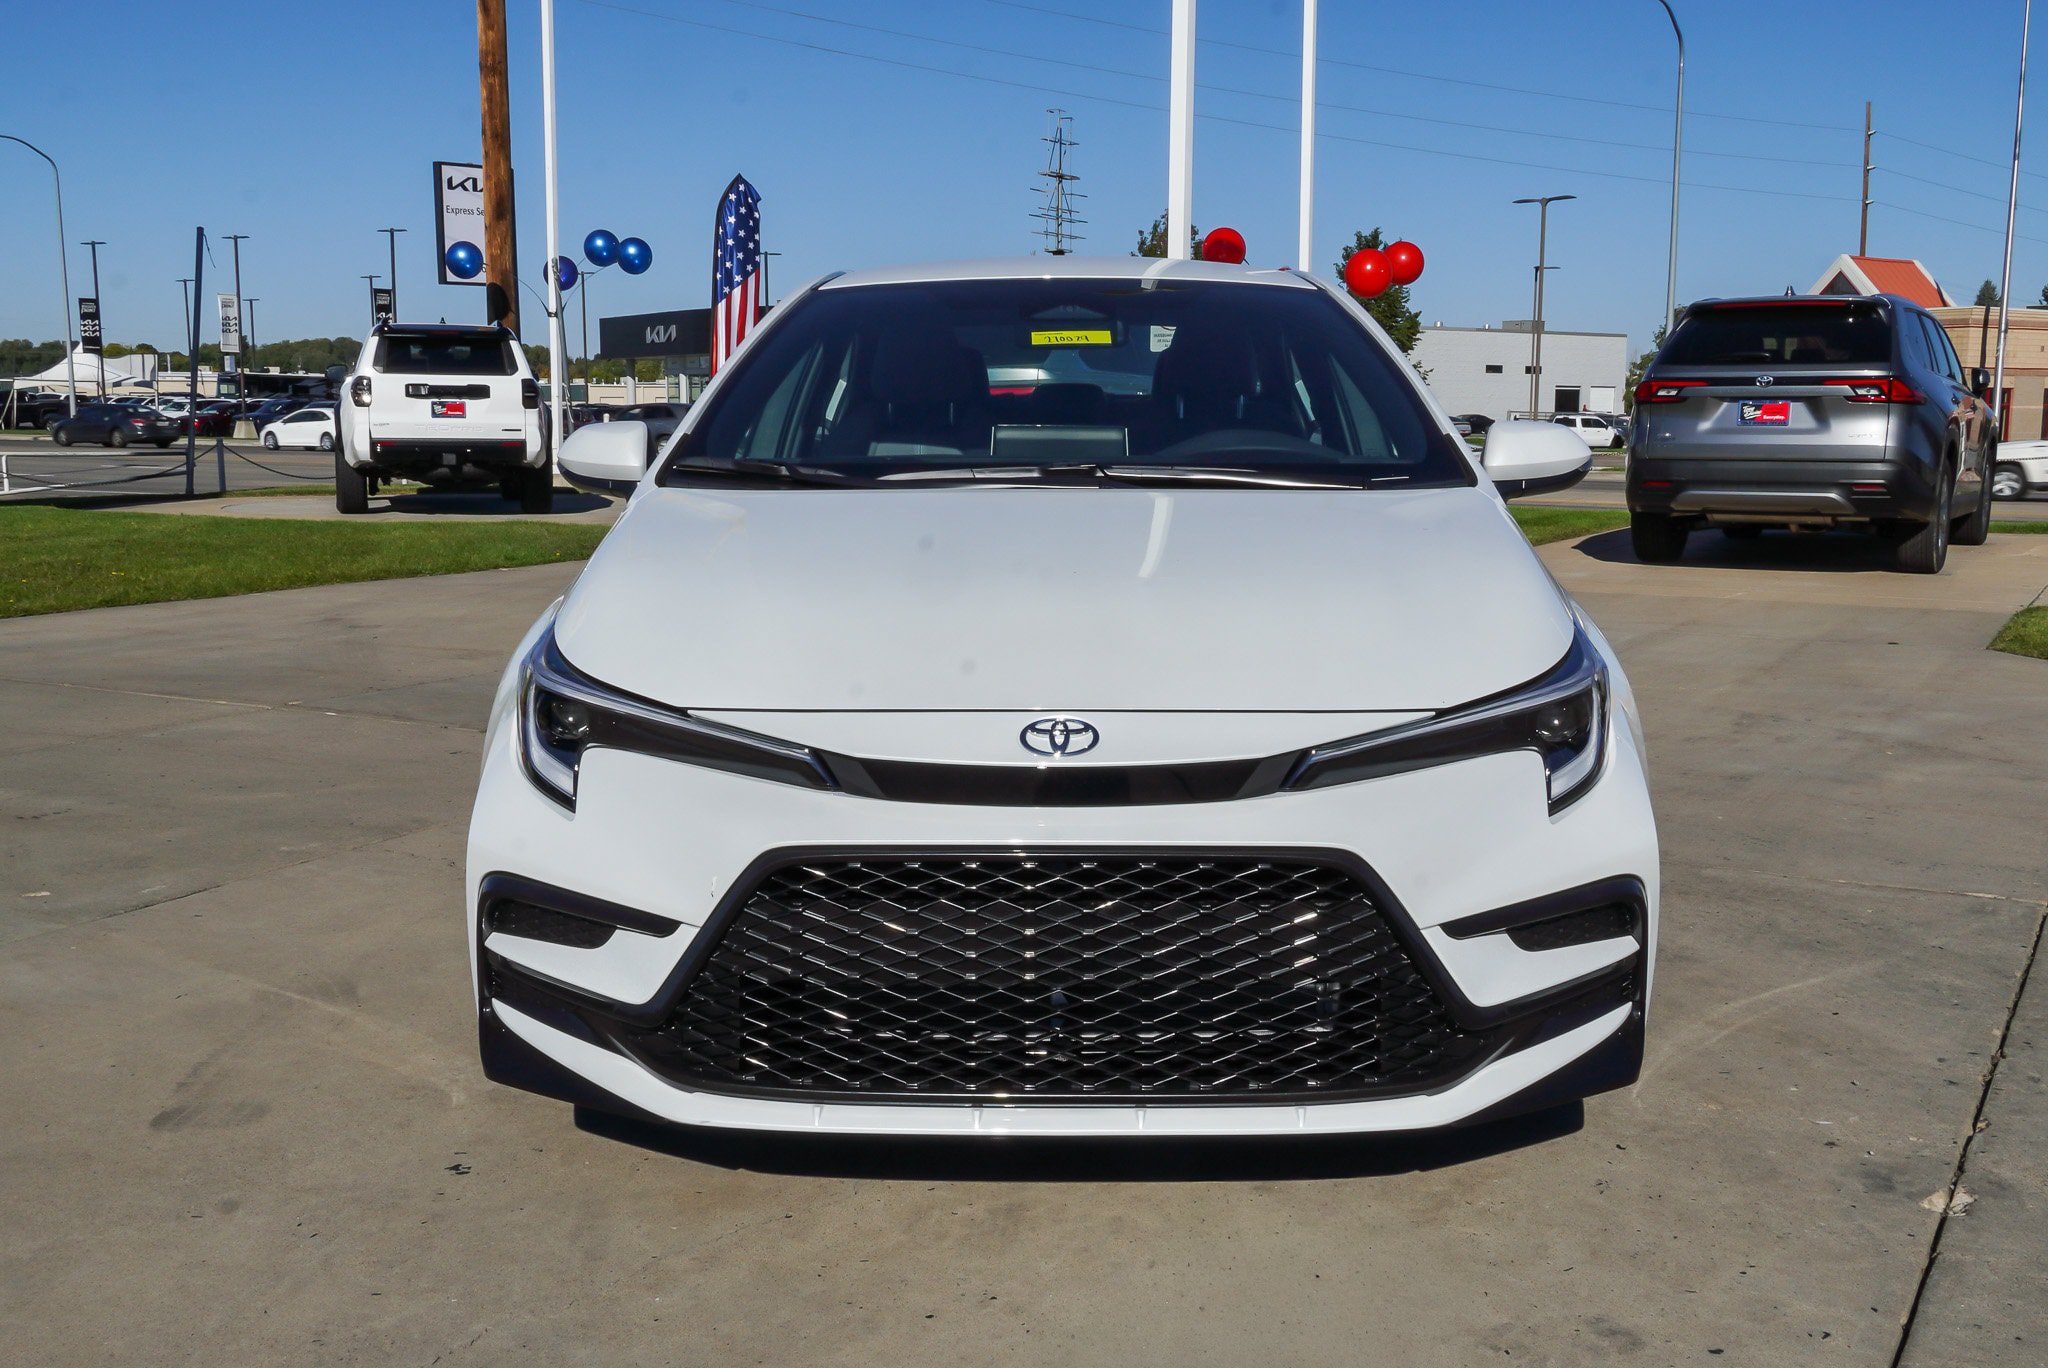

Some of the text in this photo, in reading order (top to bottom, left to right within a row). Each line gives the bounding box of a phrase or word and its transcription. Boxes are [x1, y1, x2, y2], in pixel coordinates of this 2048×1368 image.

[447, 176, 484, 192] KI
[446, 205, 475, 216] Express
[645, 325, 677, 343] KIA
